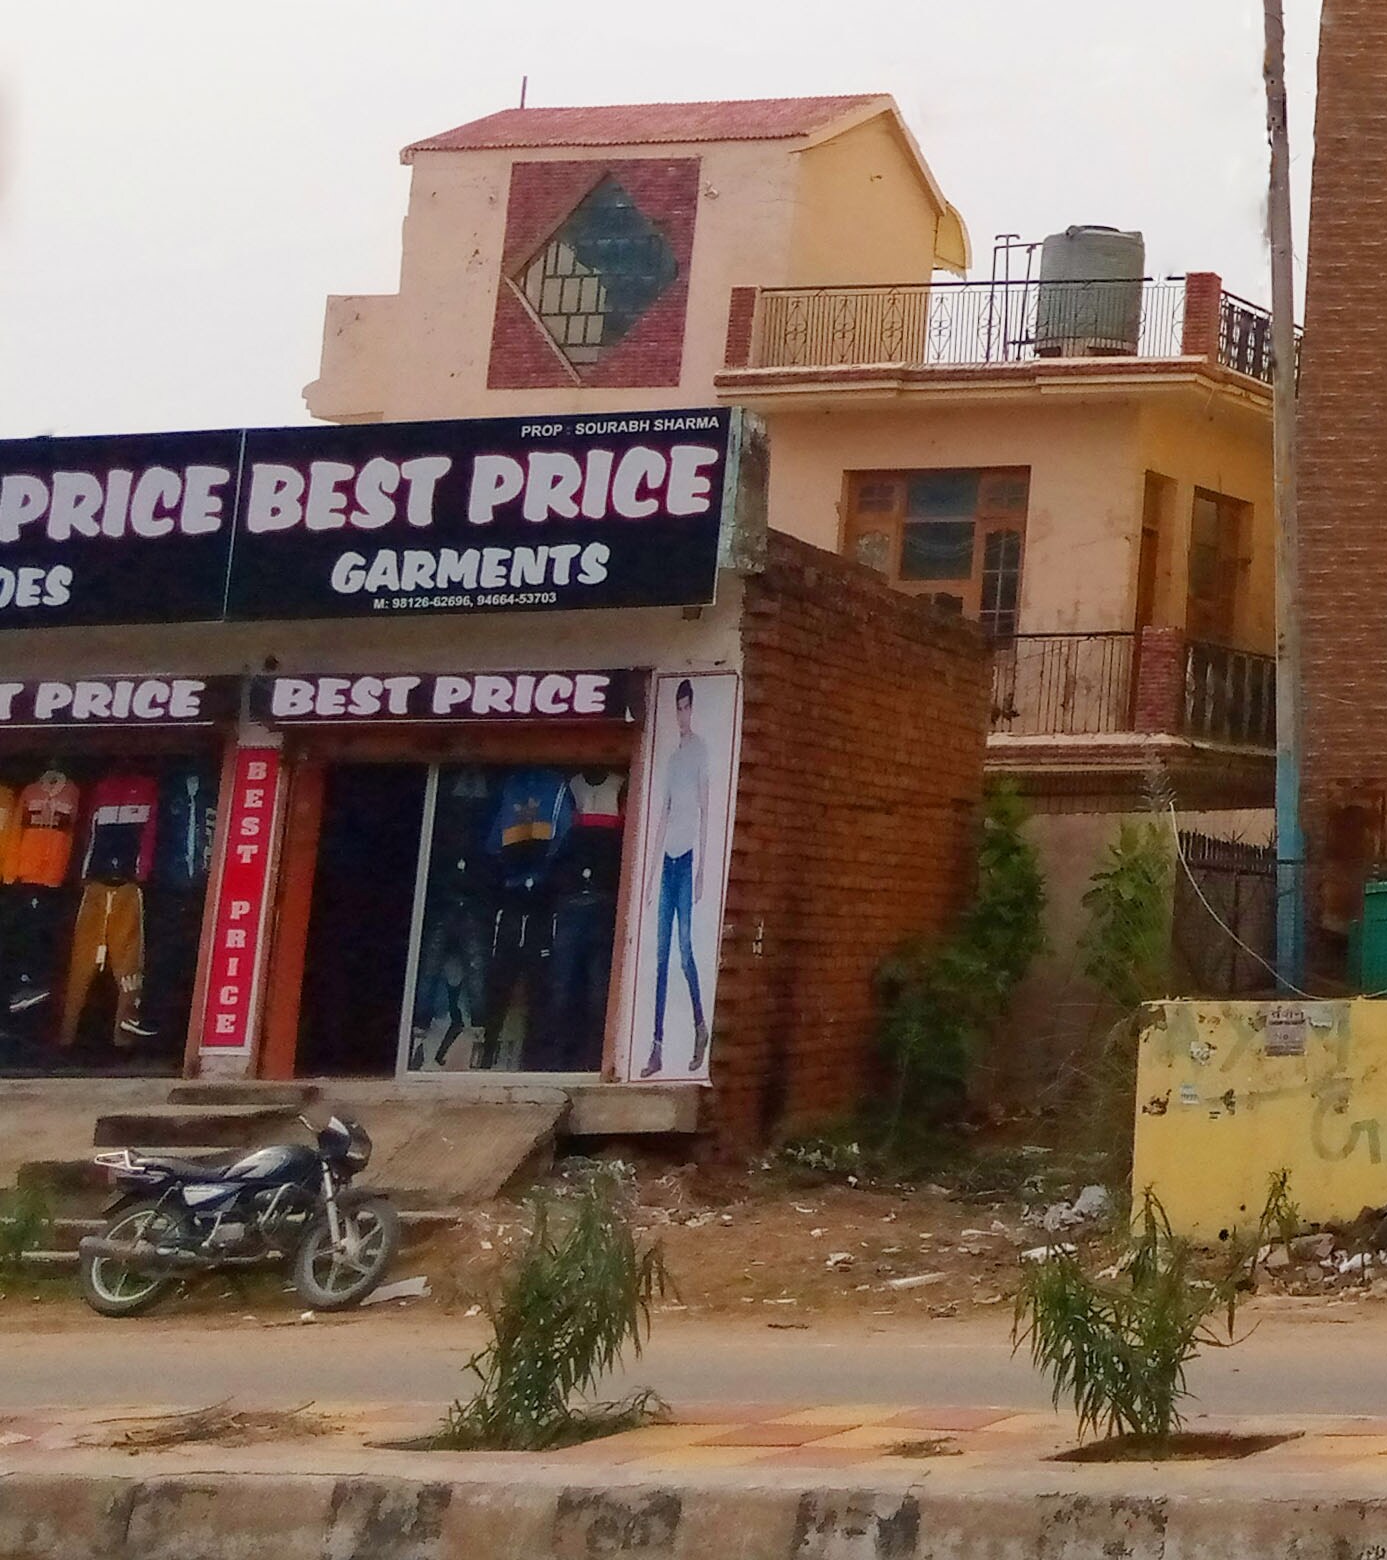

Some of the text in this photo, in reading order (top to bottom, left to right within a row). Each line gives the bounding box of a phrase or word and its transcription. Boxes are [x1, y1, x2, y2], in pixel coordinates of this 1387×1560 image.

[521, 424, 562, 438] PROP
[575, 420, 650, 435] SOURABH
[654, 416, 719, 431] SHARMA
[0, 467, 230, 542] PRICE
[247, 445, 719, 535] BEST PRICE
[331, 542, 610, 593] GARMENTS
[374, 598, 389, 609] M:
[34, 680, 206, 720] PRICE
[271, 674, 610, 716] BEST PRICE
[215, 761, 268, 1033] BEST PRICE
